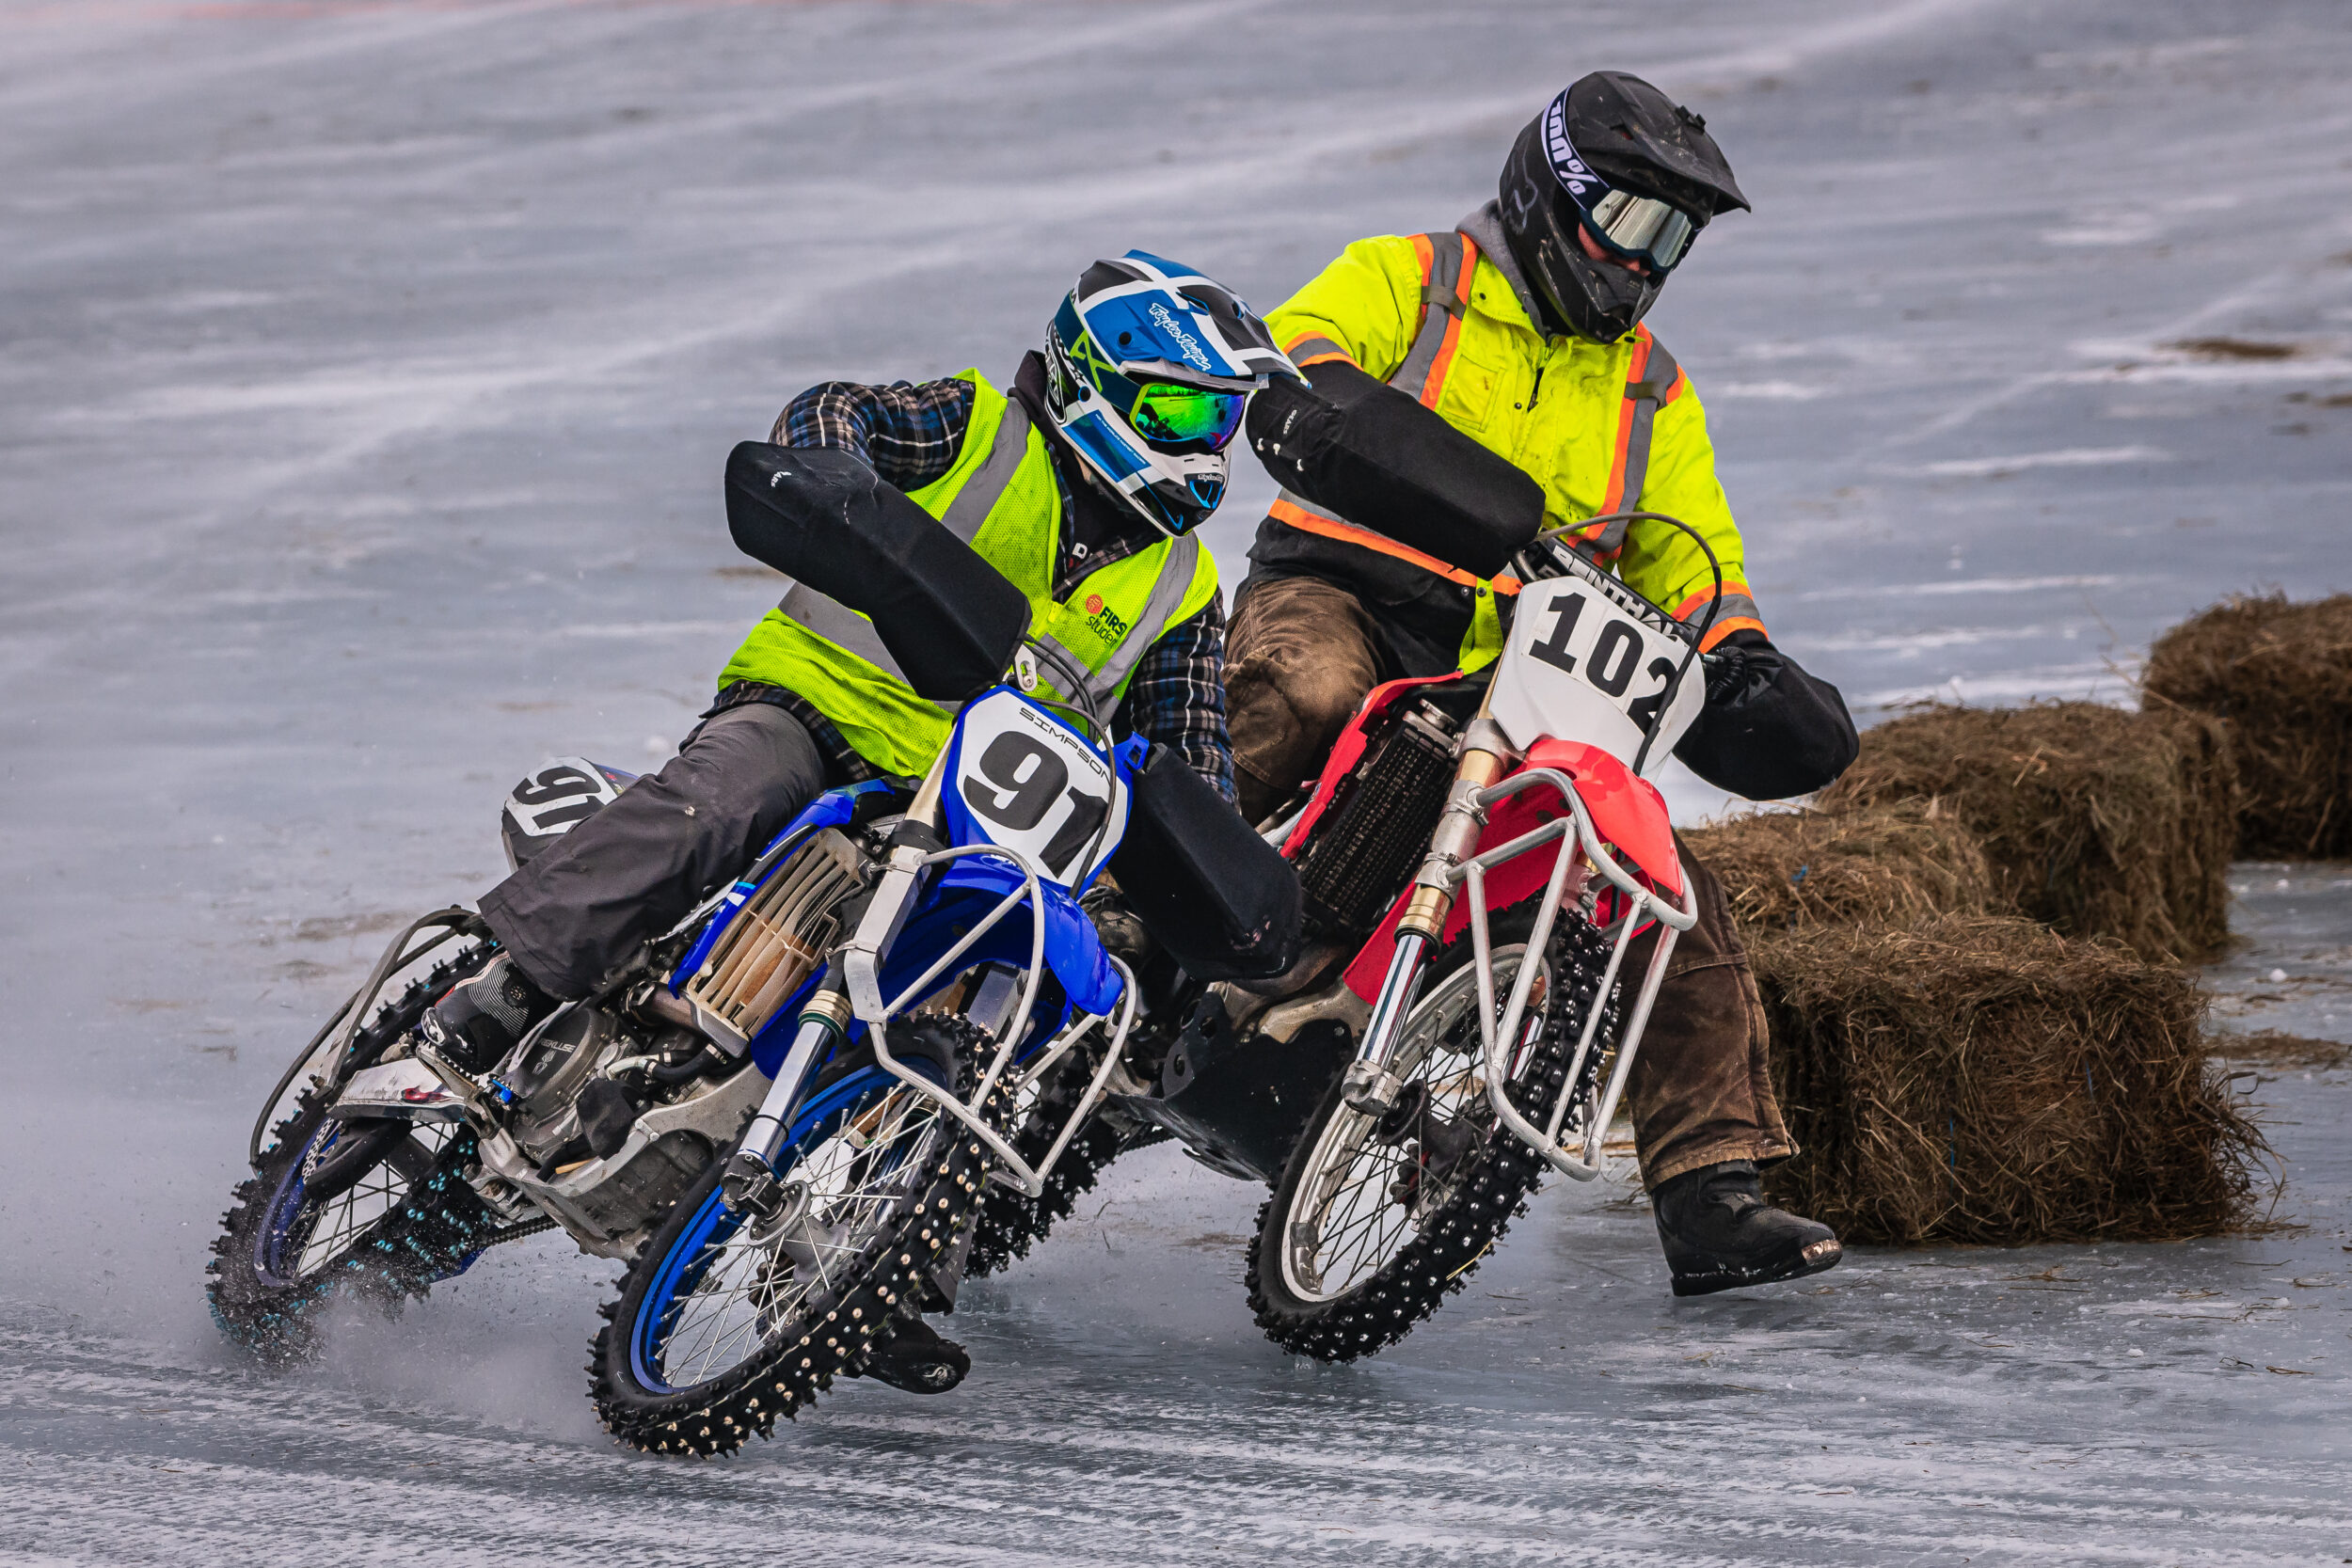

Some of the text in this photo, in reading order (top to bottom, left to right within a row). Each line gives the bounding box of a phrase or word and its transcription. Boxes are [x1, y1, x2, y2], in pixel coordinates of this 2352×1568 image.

[1149, 302, 1171, 327] Troy
[1099, 606, 1128, 638] FIRS
[1529, 592, 1677, 736] 102
[1019, 707, 1111, 789] SIMPSON
[512, 766, 605, 830] 91
[963, 731, 1108, 879] 91
